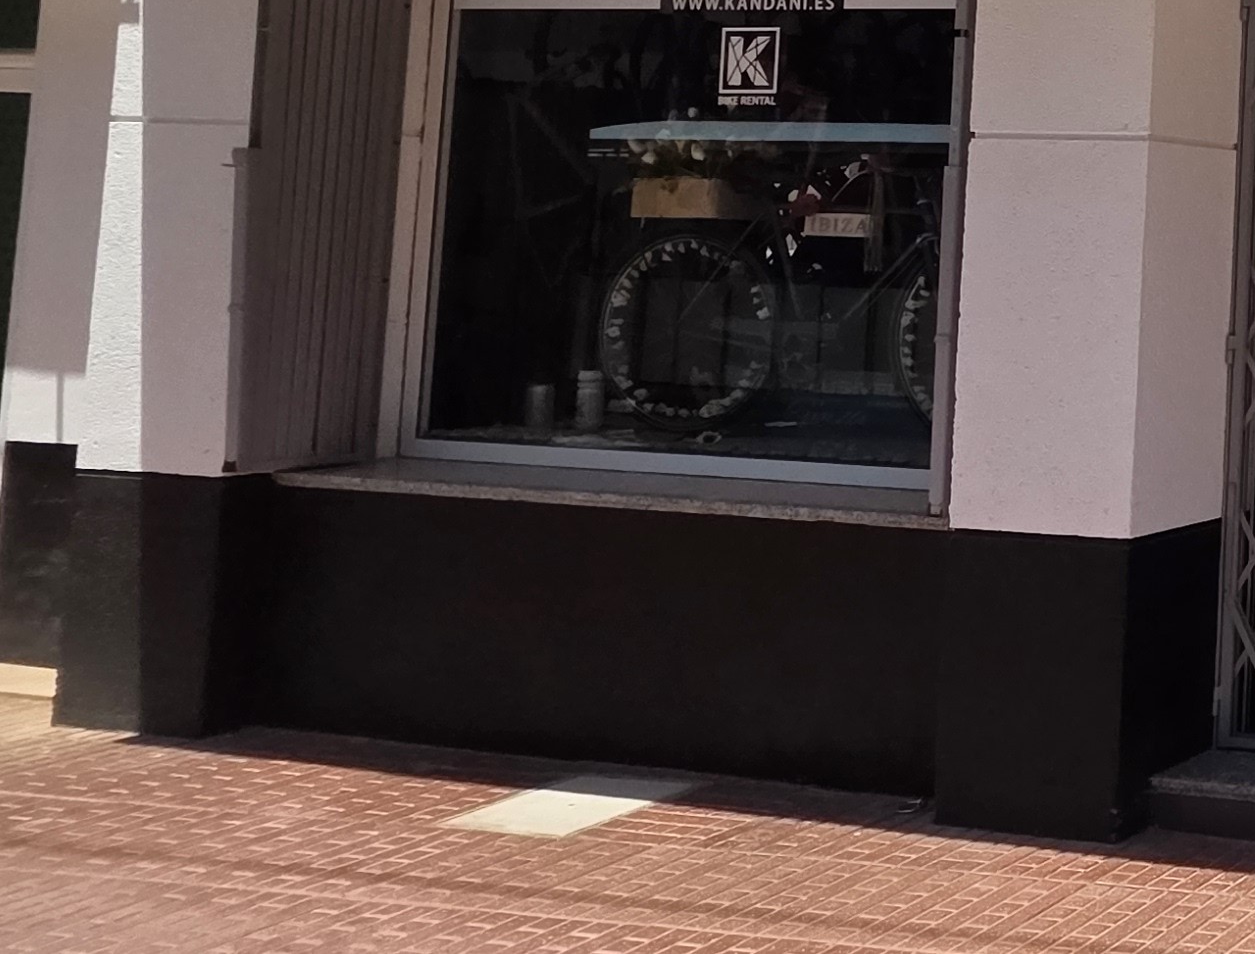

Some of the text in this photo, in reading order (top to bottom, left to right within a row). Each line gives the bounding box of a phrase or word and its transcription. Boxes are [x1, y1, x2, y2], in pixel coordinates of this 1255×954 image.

[727, 36, 771, 86] K
[718, 96, 776, 106] BIKE RENTAL
[810, 216, 867, 234] IBIZA
